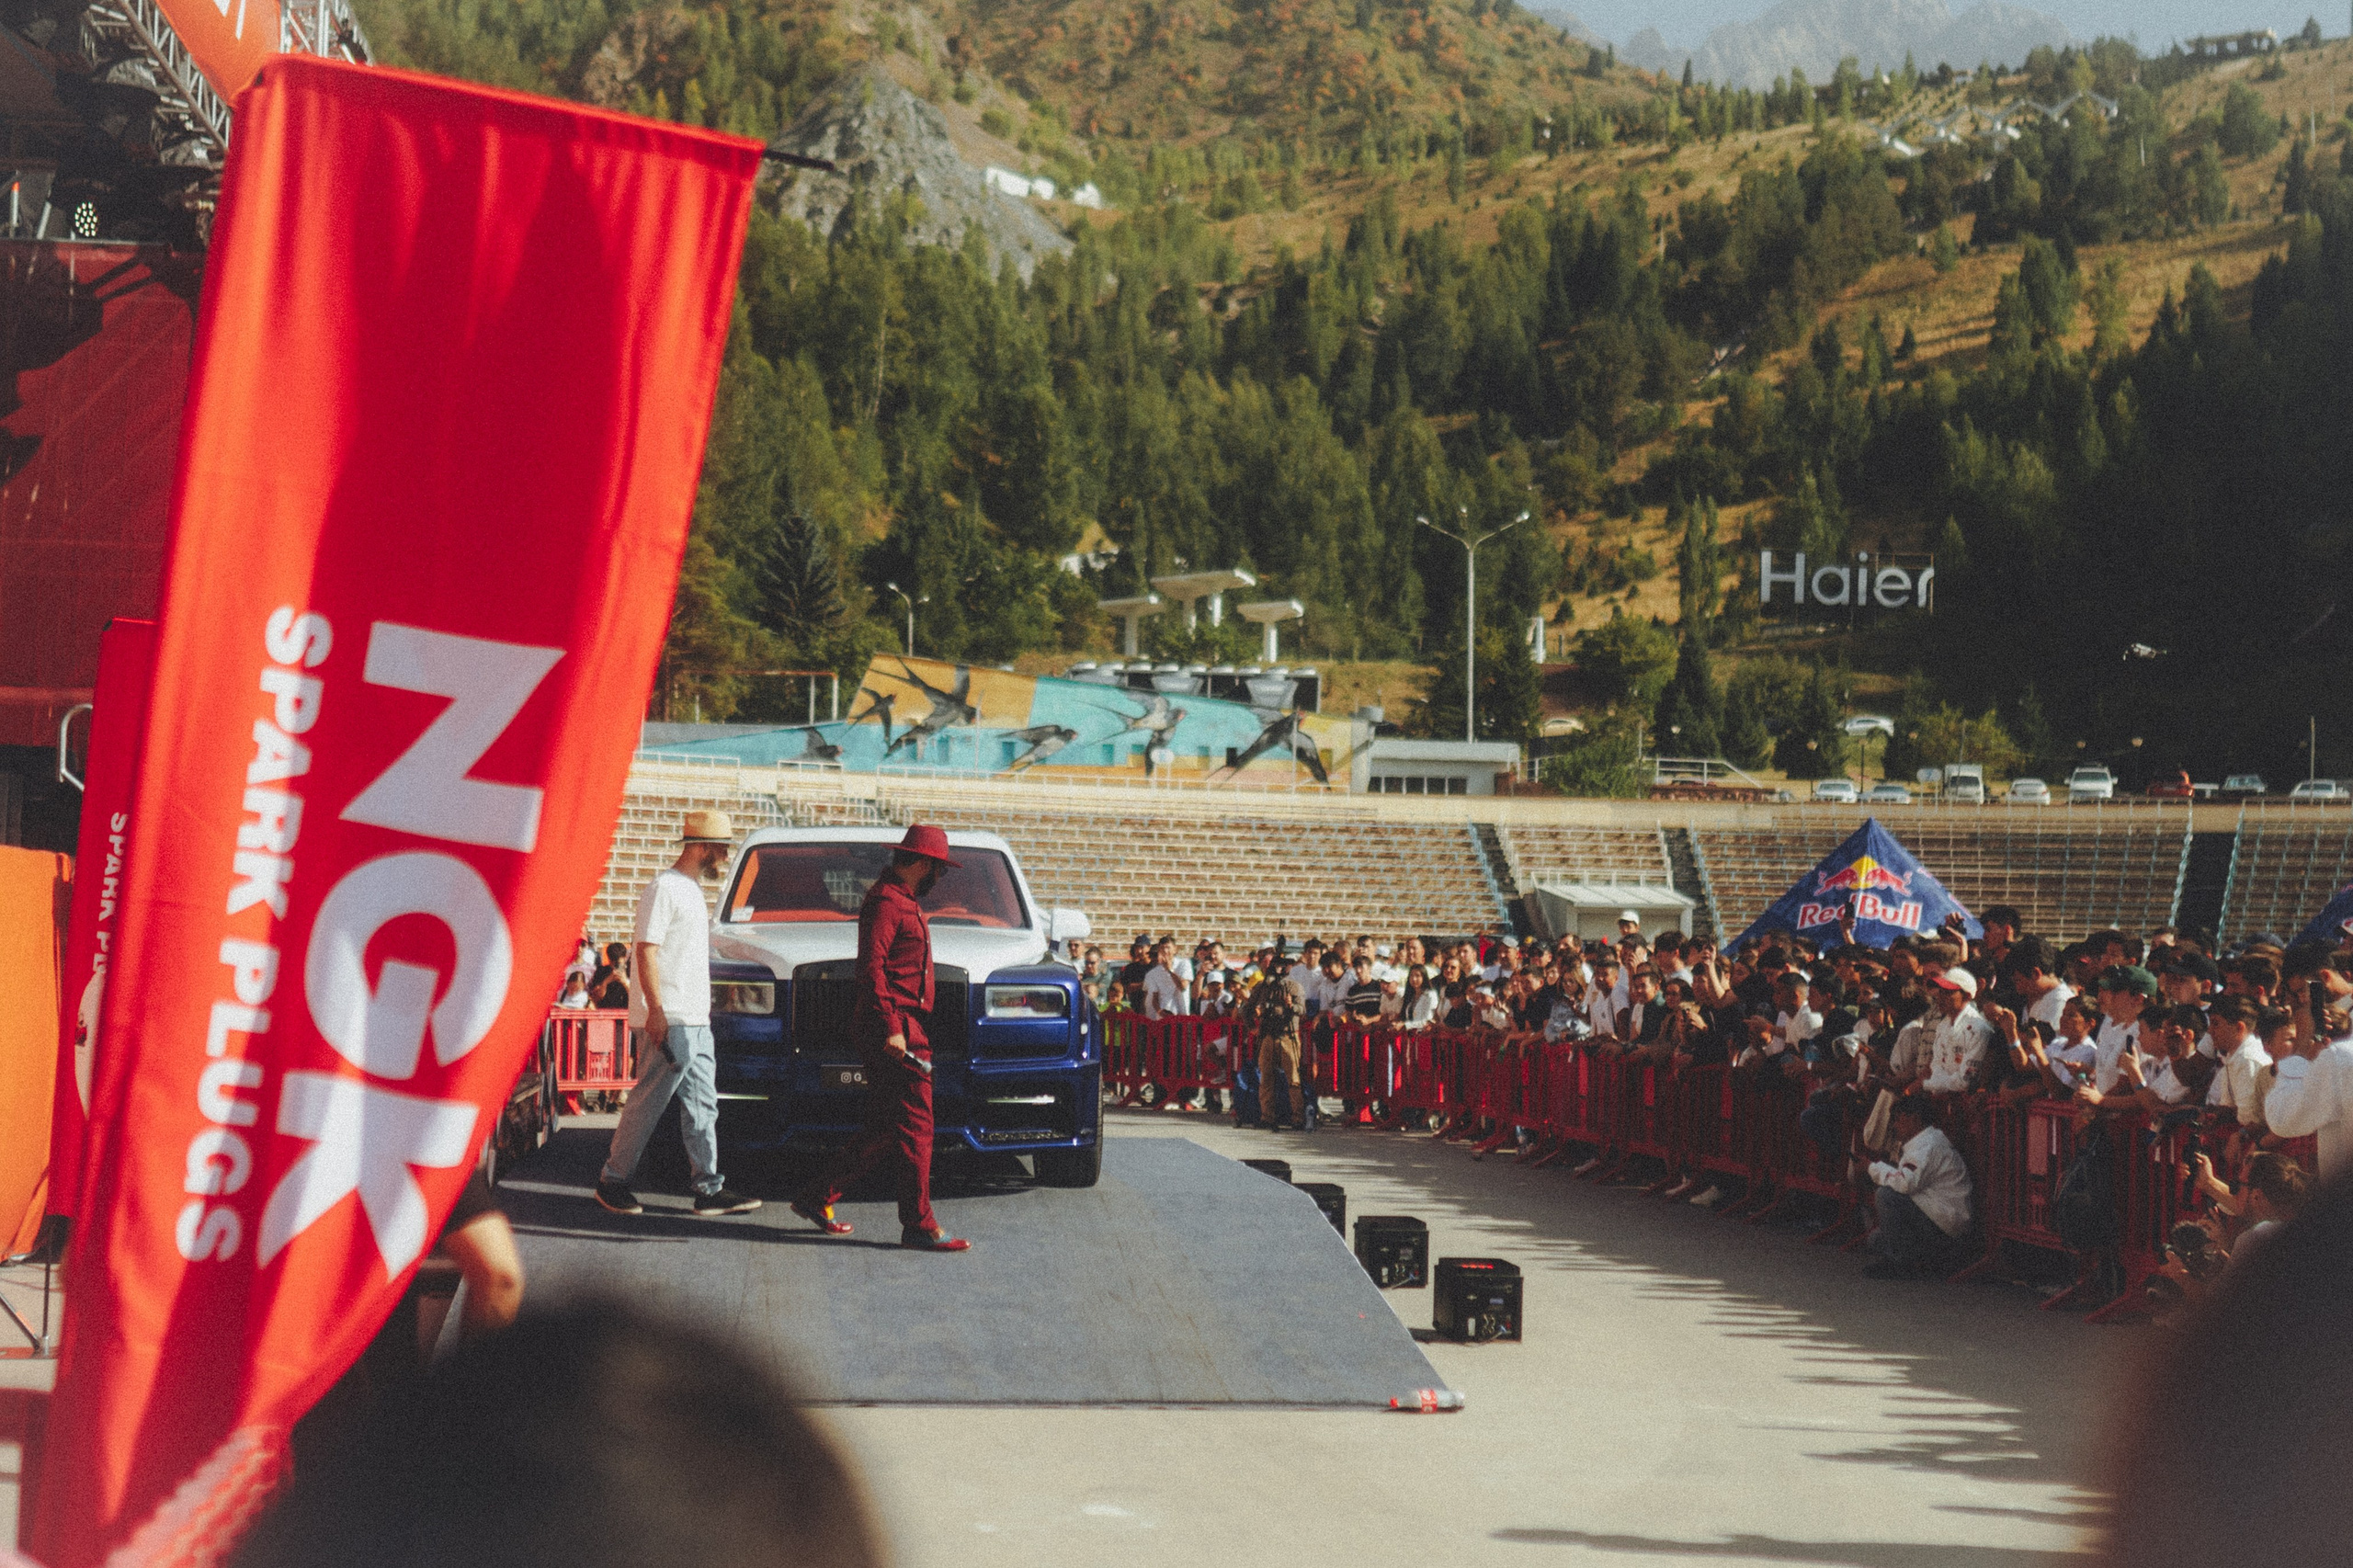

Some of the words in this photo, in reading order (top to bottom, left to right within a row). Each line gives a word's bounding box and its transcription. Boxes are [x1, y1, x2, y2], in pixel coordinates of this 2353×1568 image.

[1760, 551, 1935, 608] Haier
[226, 604, 334, 922] SPARK
[1857, 892, 1922, 930] Bull
[175, 936, 280, 1263] PLUGS
[256, 619, 567, 1285] NGK
